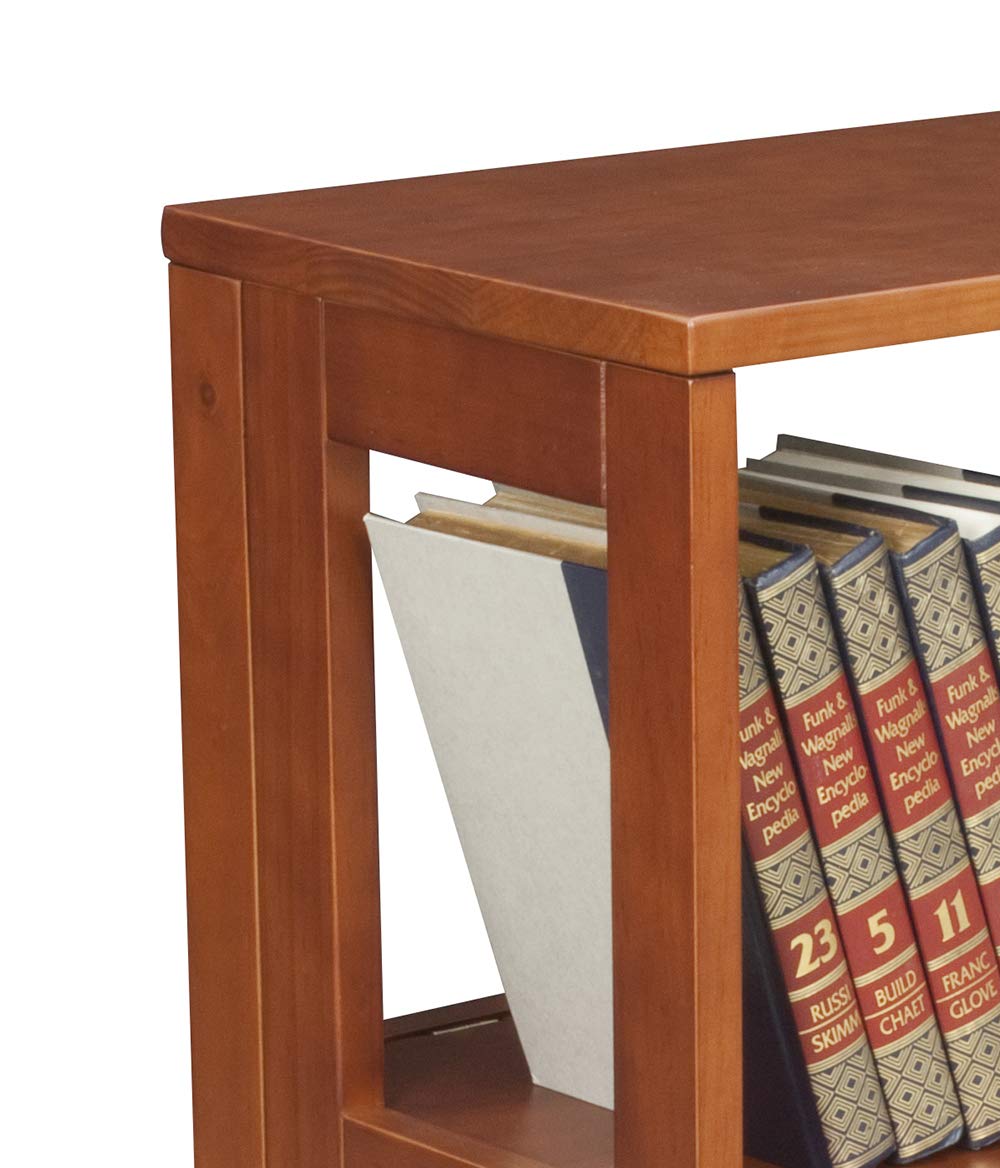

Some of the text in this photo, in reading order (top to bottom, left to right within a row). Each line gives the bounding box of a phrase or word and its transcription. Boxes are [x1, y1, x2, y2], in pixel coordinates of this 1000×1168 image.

[876, 678, 918, 718] Funk &
[947, 665, 991, 704] Funk &
[739, 707, 776, 743] unk &
[802, 692, 848, 731] Funk &
[944, 686, 999, 730] Wagnalls
[895, 733, 925, 762] New
[965, 719, 996, 748] New
[752, 762, 784, 793] New
[822, 746, 854, 776] New
[831, 791, 869, 829] pedia
[904, 777, 941, 815] pedia
[762, 808, 799, 846] pedia
[867, 908, 896, 955] 5
[933, 888, 971, 942] 11
[790, 918, 838, 979] 23
[874, 970, 917, 1007] BUILD
[942, 951, 990, 993] FRANC
[810, 984, 852, 1023] RUSSI
[879, 993, 926, 1035] CHAET
[949, 979, 998, 1019] GLOVE
[811, 1009, 862, 1053] SKIMM
